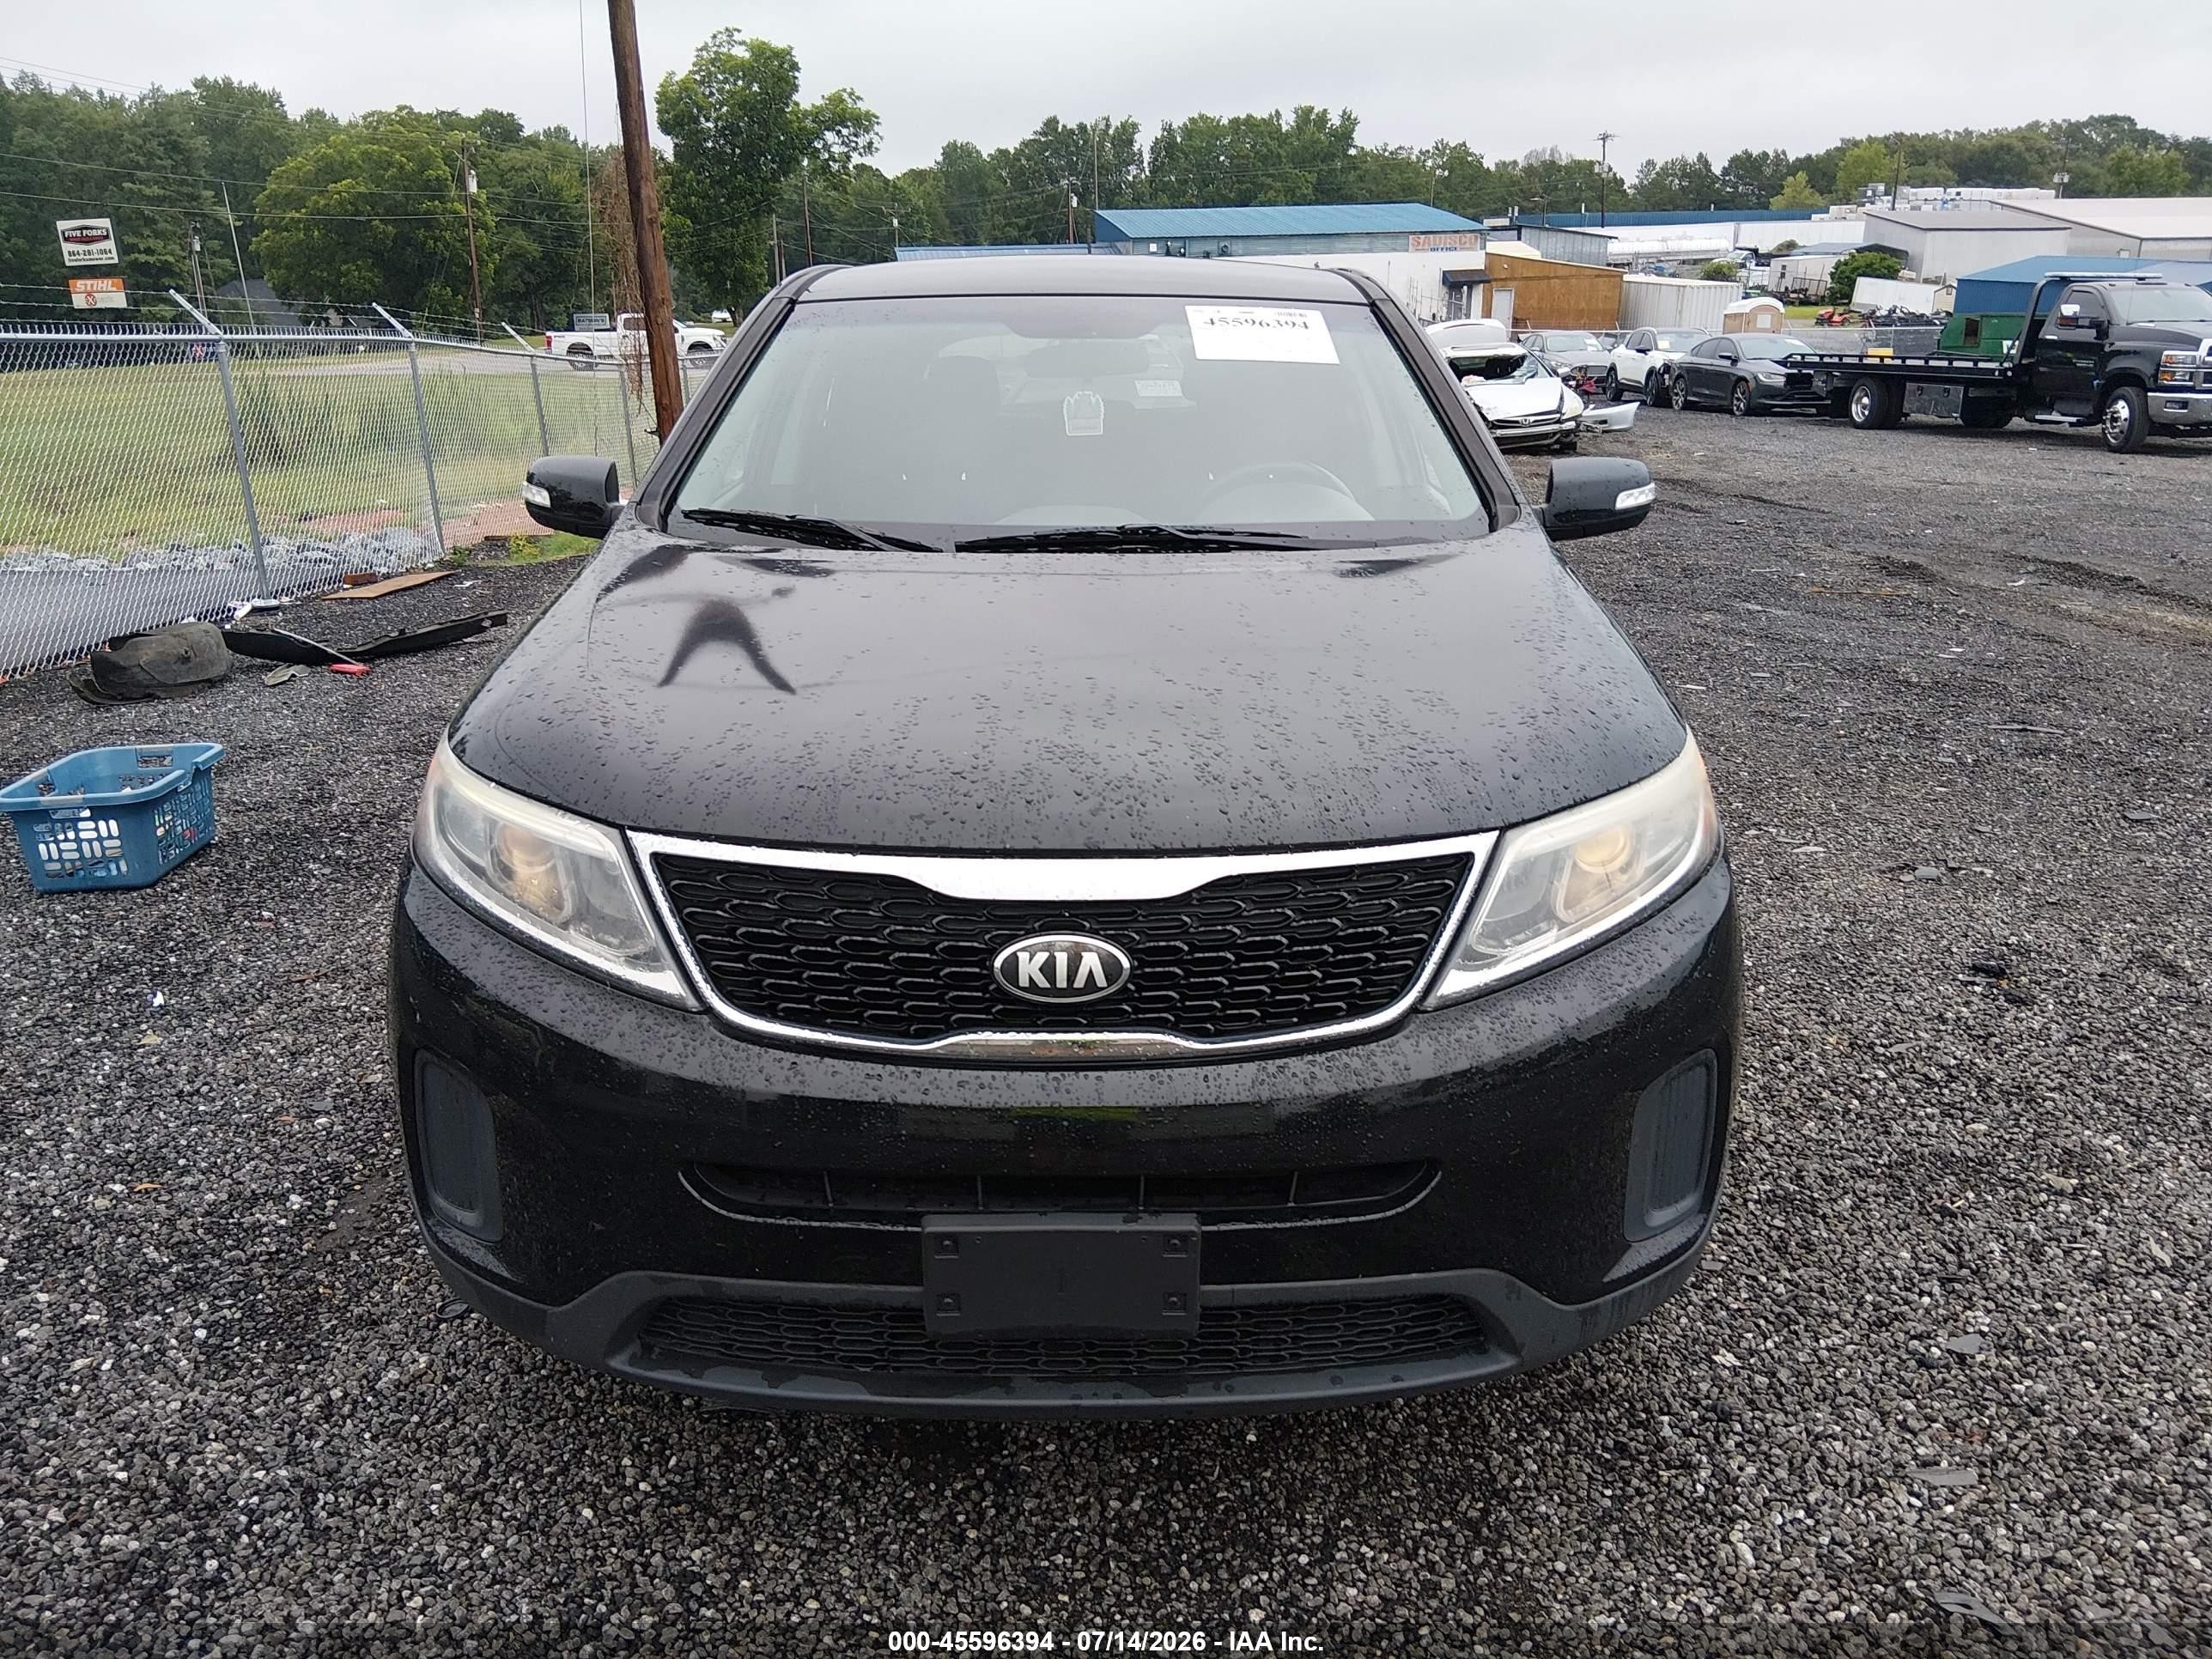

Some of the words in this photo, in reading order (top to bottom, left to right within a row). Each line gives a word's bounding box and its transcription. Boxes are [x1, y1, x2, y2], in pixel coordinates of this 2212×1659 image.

[82, 228, 107, 237] FORKS
[1411, 234, 1479, 247] SADISCO
[74, 280, 117, 291] STIHL
[1204, 317, 1310, 331] 45596394
[1016, 951, 1109, 989] KIA
